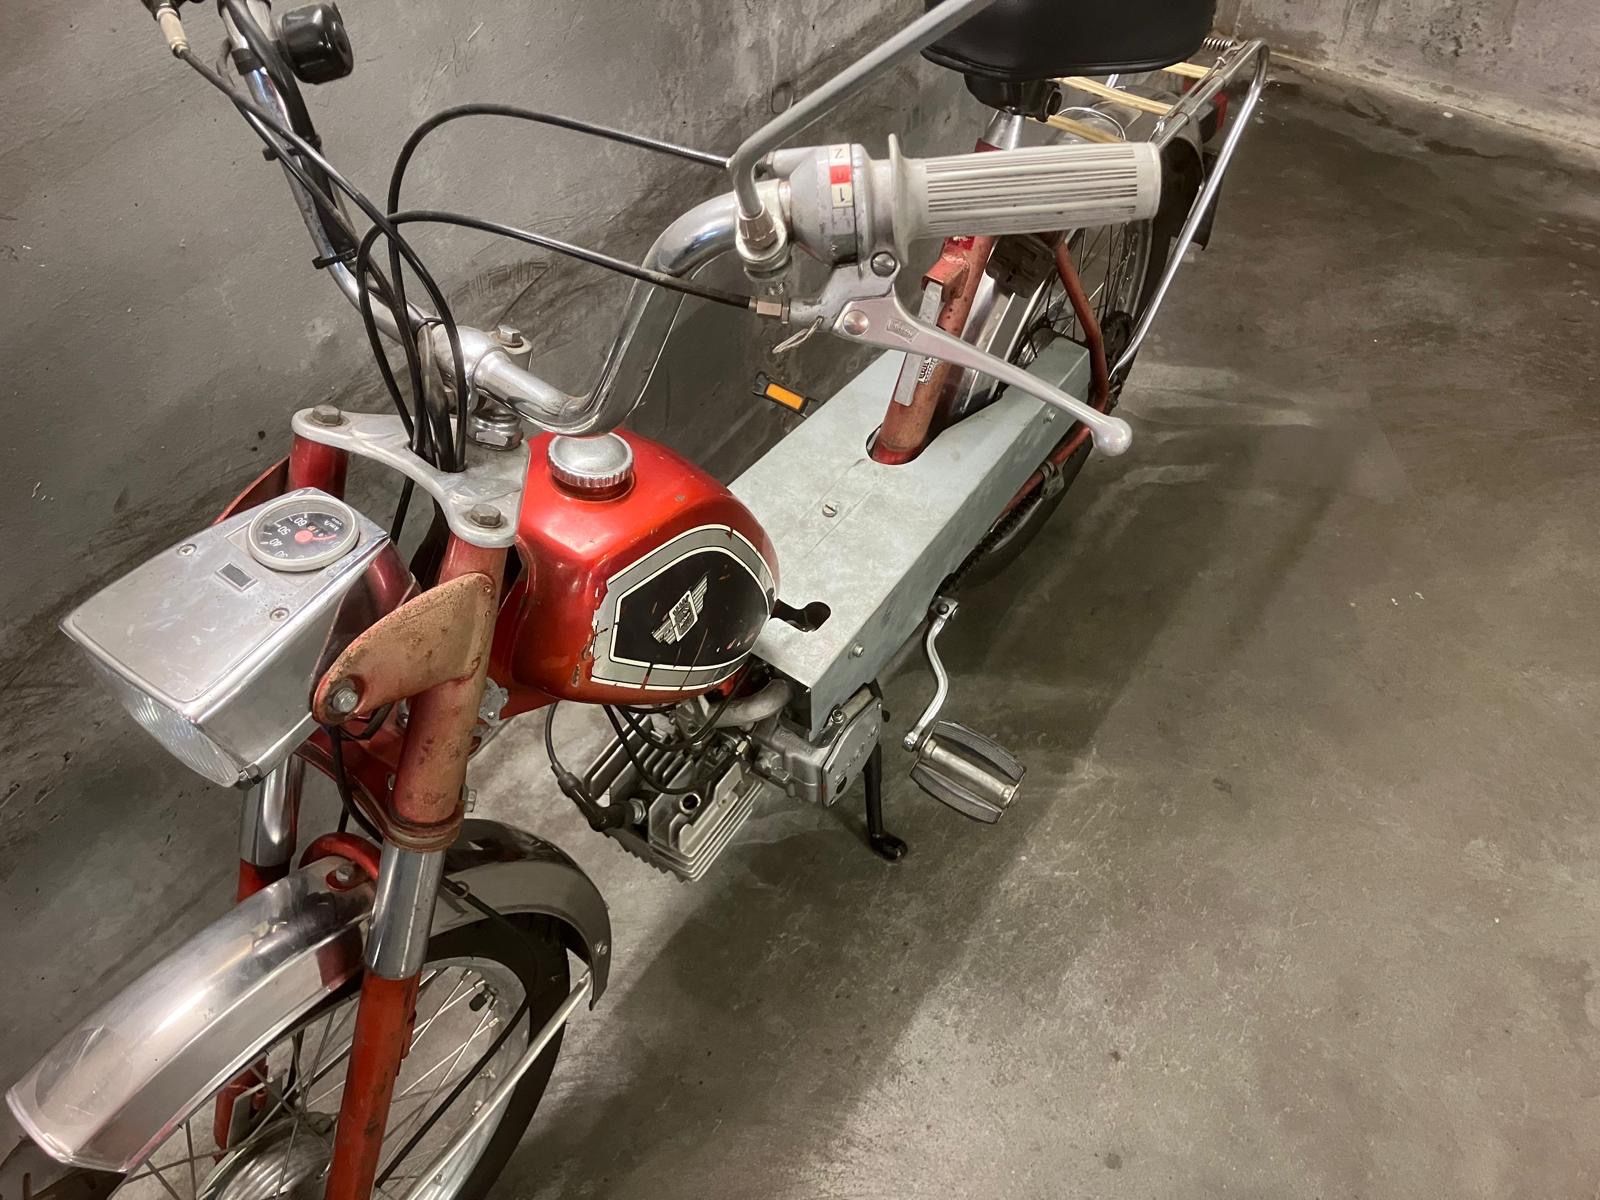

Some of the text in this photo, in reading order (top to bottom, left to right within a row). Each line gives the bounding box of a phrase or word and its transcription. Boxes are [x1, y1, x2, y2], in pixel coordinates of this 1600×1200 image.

[294, 517, 307, 527] 60
[277, 526, 291, 535] 50
[269, 538, 282, 547] 40
